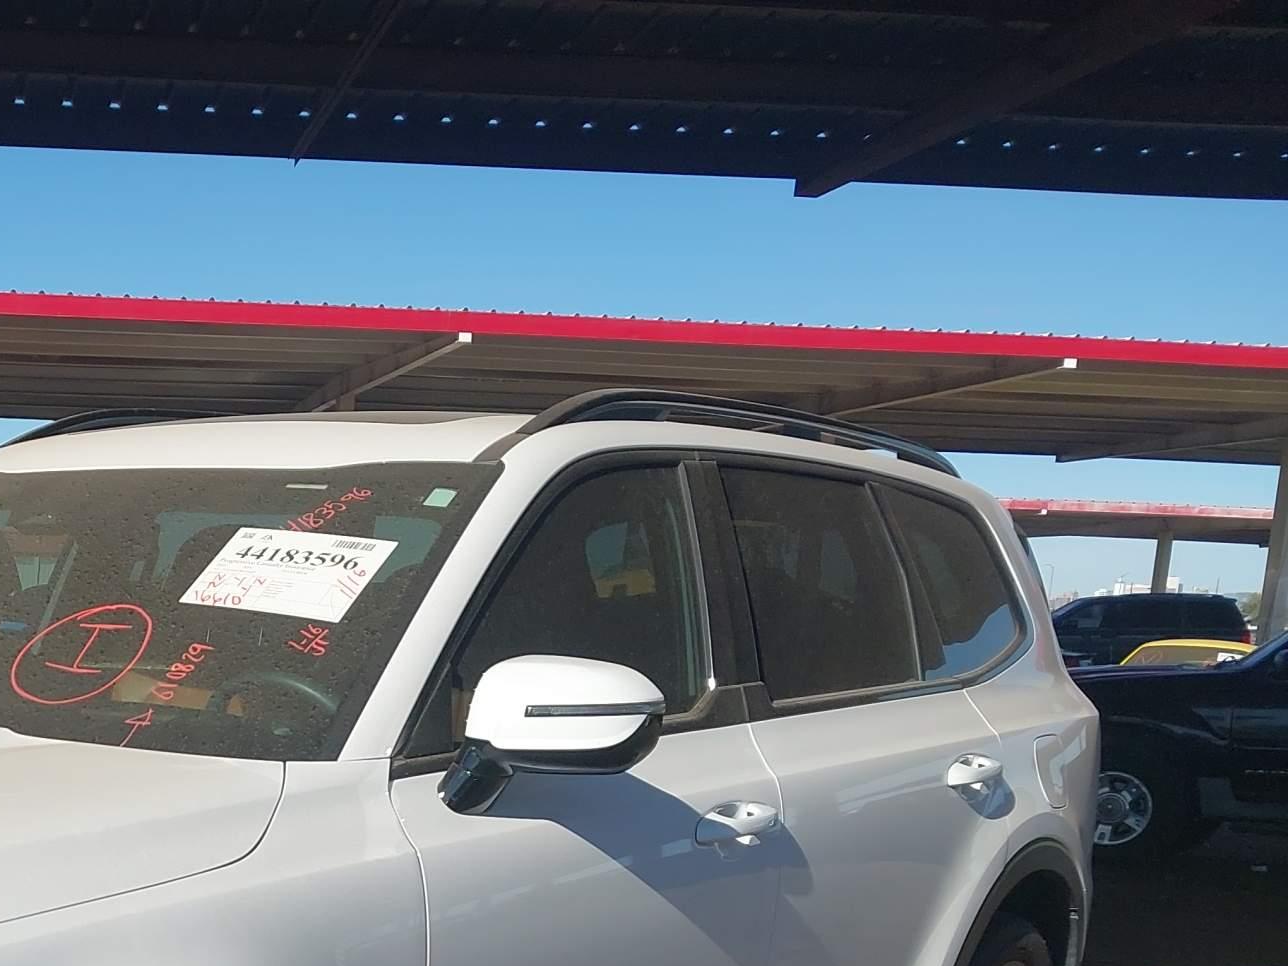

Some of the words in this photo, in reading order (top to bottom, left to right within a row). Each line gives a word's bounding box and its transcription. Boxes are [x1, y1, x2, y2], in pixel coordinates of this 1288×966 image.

[281, 486, 373, 532] 4183596
[235, 544, 360, 571] 44183596
[150, 642, 217, 701] 610829
